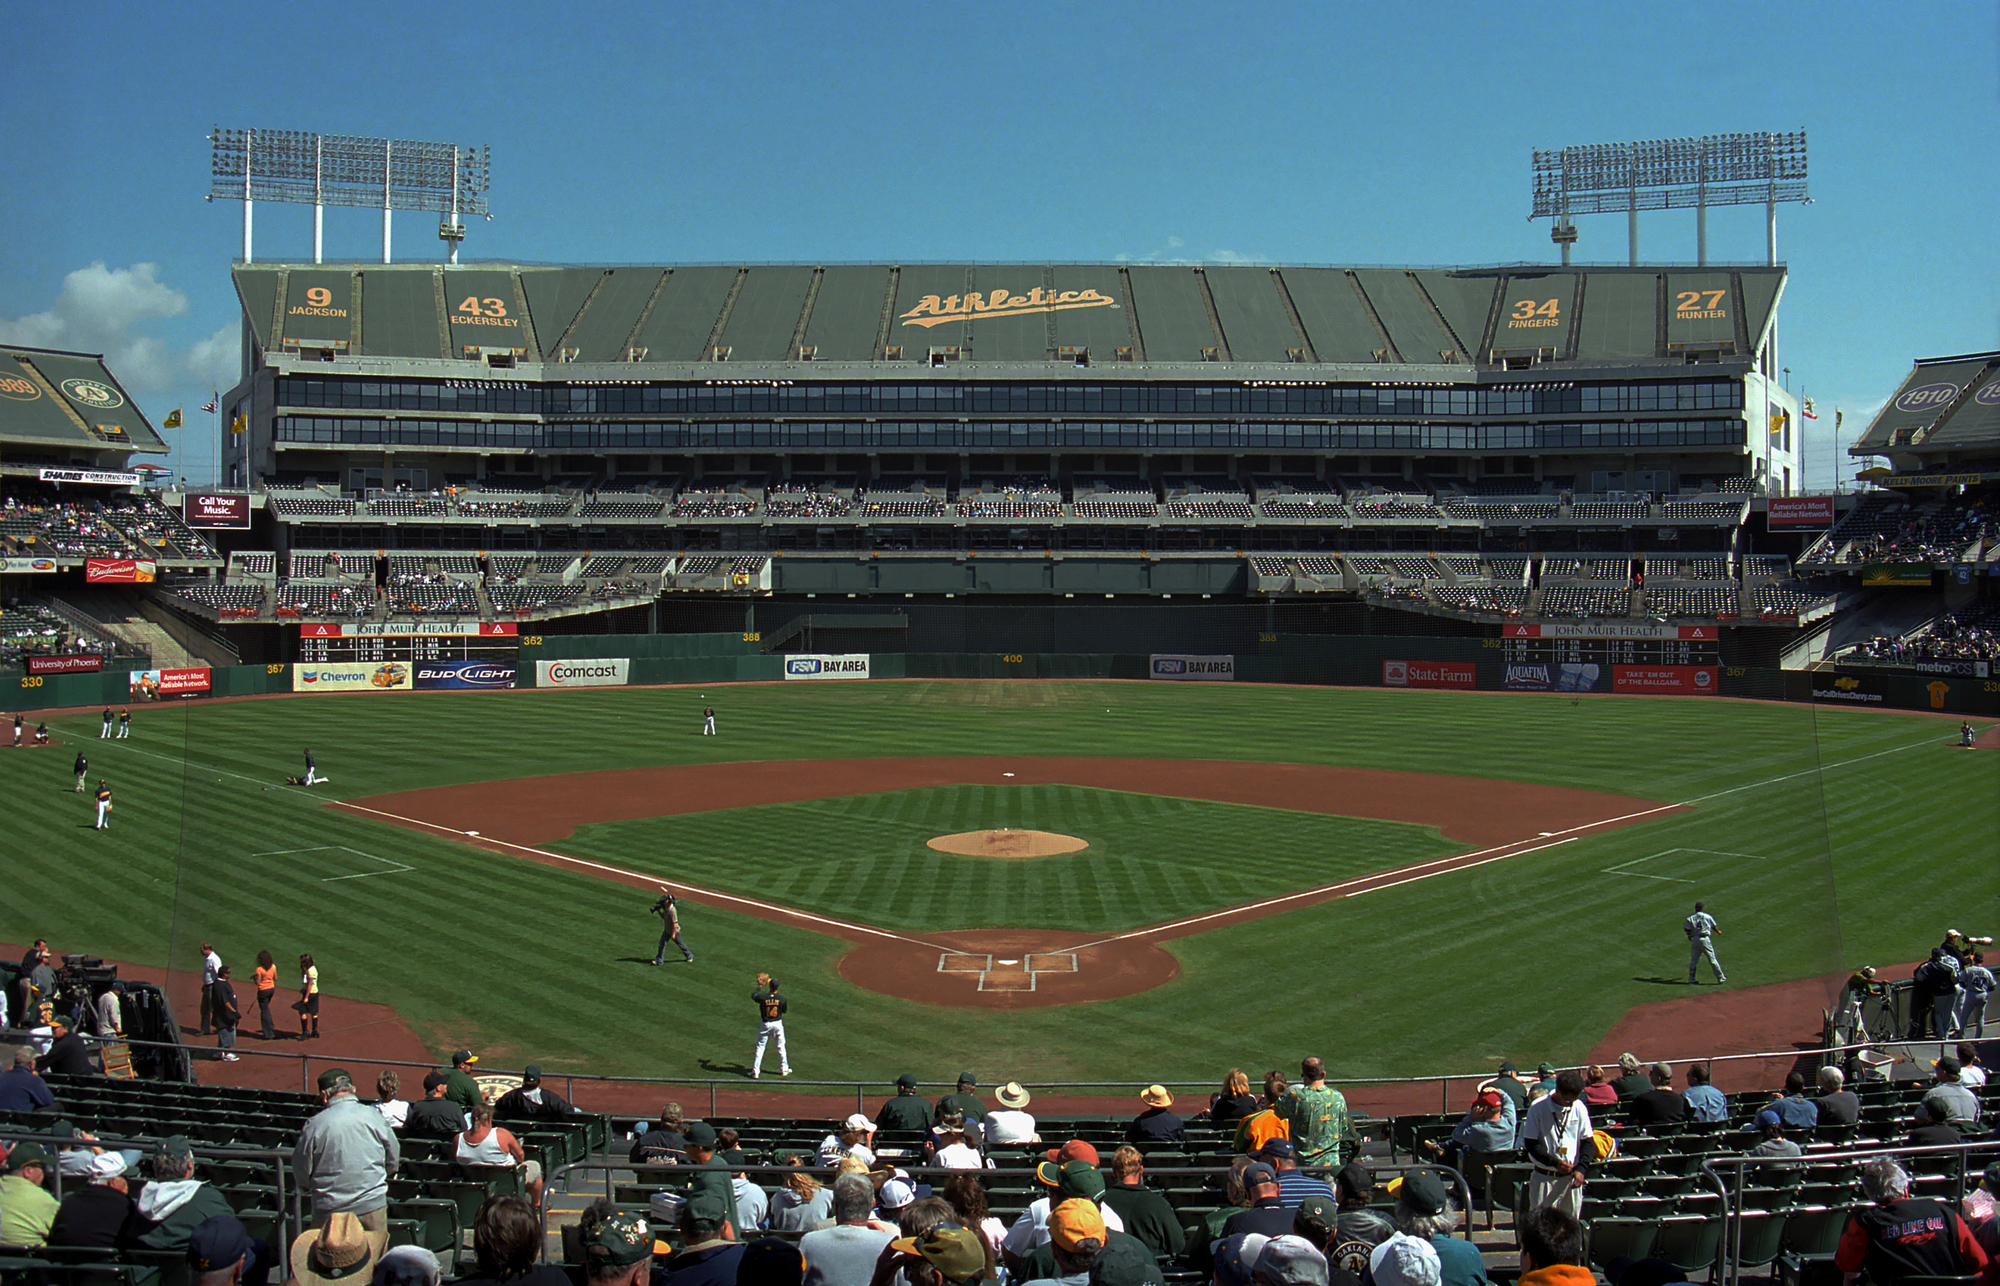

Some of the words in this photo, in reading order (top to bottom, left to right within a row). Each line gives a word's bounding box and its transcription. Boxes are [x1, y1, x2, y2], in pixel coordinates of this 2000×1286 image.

[306, 287, 332, 307] 9
[1676, 290, 1726, 311] 27
[458, 296, 507, 318] 43
[899, 286, 1114, 322] Athletics
[1511, 298, 1561, 320] 34
[288, 306, 347, 318] JACKSON
[1677, 309, 1726, 320] HUNTER
[451, 315, 518, 328] ECKERSLEY
[1508, 318, 1559, 329] FINGERS
[1903, 388, 1953, 405] 1910
[85, 472, 137, 481] CONSTRUCTION
[1882, 476, 1944, 487] KELLY-MOORE
[1945, 474, 1979, 485] PAINTS
[198, 496, 215, 505] Call
[216, 497, 236, 506] Your
[1807, 502, 1827, 510] Most
[203, 506, 231, 514] Music.
[1798, 510, 1832, 518] Network.
[89, 565, 135, 577] Budweiser
[356, 624, 385, 635] JOHN
[389, 624, 419, 633] MUIR
[1554, 625, 1583, 636] JOHN
[1587, 626, 1616, 635] MUIR
[1617, 626, 1663, 636] HEALTH
[523, 636, 543, 646] 362
[742, 633, 760, 642] 388
[1259, 633, 1277, 642] 388
[1481, 639, 1501, 648] 362
[32, 660, 66, 669] University
[66, 658, 73, 667] of
[73, 658, 100, 667] Phoenix
[1003, 654, 1023, 663] 400
[267, 664, 285, 674] 367
[791, 661, 817, 673] FSN
[823, 661, 841, 672] BAY
[841, 661, 867, 672] AREA
[1158, 661, 1182, 673] FSN
[1188, 661, 1206, 673] BAY
[1207, 662, 1232, 673] AREA
[1726, 667, 1746, 676] 367
[1916, 661, 1972, 674] metroPCS
[163, 673, 190, 681] America's
[320, 671, 366, 682] Chevron
[417, 670, 456, 678] BUD
[464, 670, 516, 678] LIGHT
[1409, 666, 1438, 680] State
[1440, 667, 1473, 682] Farm
[1504, 663, 1551, 683] AQUAFINA
[21, 676, 44, 688] 330
[160, 680, 183, 688] Reliable
[183, 679, 209, 687] Network.
[1984, 681, 2000, 692] 33
[766, 1006, 778, 1017] 14
[1901, 1219, 1925, 1235] LINE
[1926, 1216, 1944, 1231] OIL
